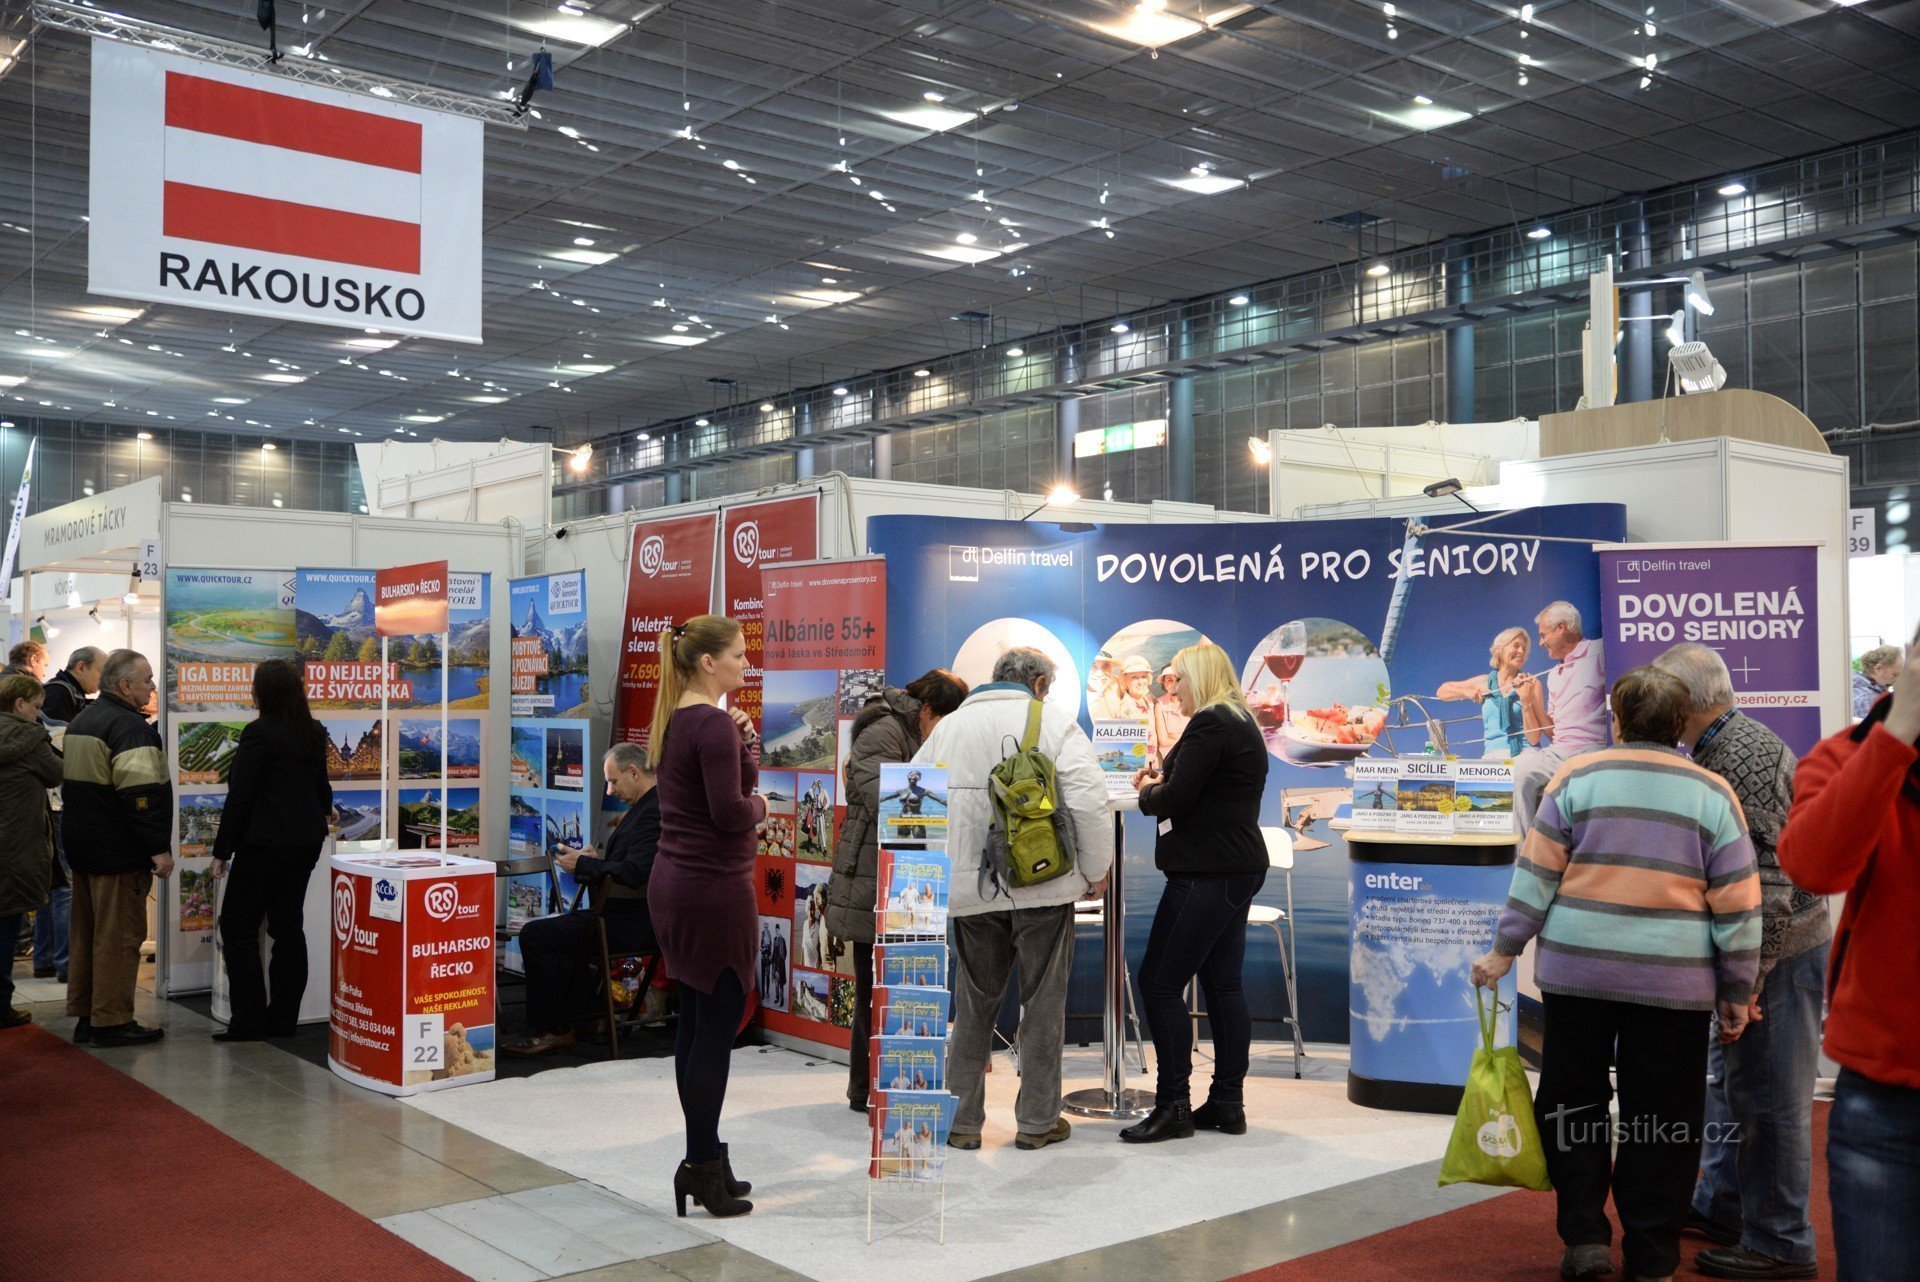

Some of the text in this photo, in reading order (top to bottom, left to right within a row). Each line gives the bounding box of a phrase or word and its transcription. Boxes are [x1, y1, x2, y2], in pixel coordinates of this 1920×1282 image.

[159, 251, 426, 322] RAKOUSKO
[44, 510, 95, 548] MRAMOROVÉ
[98, 506, 127, 534] TÁCKY
[1852, 515, 1864, 530] F
[147, 544, 155, 557] F
[738, 529, 776, 560] RS tour
[1850, 536, 1870, 552] 39
[644, 543, 678, 571] RS tour
[982, 547, 1026, 565] Delfin
[1031, 550, 1073, 566] travel
[1096, 539, 1541, 584] DOVOLENÁ PRO SENIORY
[143, 562, 158, 576] 23
[1642, 560, 1676, 572] Delfin
[1679, 559, 1711, 571] travel
[177, 574, 253, 584] WWW.QUICKTOUR.CZ
[809, 576, 877, 587] www.dovolenaproseniory.cz
[381, 578, 441, 599] BULHARSKO ŘECKO
[1618, 586, 1805, 619] DOVOLENÁ
[767, 616, 875, 642] Albánie 55+
[1619, 618, 1804, 643] PRO SENIORY
[512, 637, 541, 656] POBYTOVÉ
[628, 636, 655, 652] sleva
[766, 645, 876, 659] nová láska ve Středomoří
[181, 666, 208, 682] IGA
[307, 665, 326, 681] TO
[181, 683, 226, 693] MEZINÁRODNÍ
[307, 683, 324, 699] ZE
[740, 690, 762, 702] 6.990
[1095, 726, 1146, 737] KALÁBRIE
[1356, 766, 1375, 774] MAR
[1407, 762, 1447, 774] SICÍLIE
[1459, 767, 1511, 776] MENORCA
[1365, 872, 1423, 891] enter
[429, 886, 480, 915] RS tour
[1397, 896, 1432, 905] charterová
[1434, 898, 1469, 906] společnost
[336, 888, 351, 930] RS
[354, 924, 379, 947] tour
[1370, 904, 1388, 912] druhá
[1390, 906, 1415, 914] největší
[1458, 909, 1487, 917] východní
[1370, 914, 1391, 922] letadla
[1409, 916, 1432, 926] Boeing
[1434, 918, 1461, 926] 737-400
[1370, 933, 1390, 941] držitel
[1391, 935, 1424, 943] certifikátu
[1425, 937, 1464, 946] bezpečnosti
[1473, 939, 1492, 947] kvality
[1458, 928, 1482, 936] Evropě,
[412, 936, 491, 958] BULHARSKO
[430, 961, 474, 979] ŘECKO
[414, 986, 487, 1004] VAŠE SPOKOJENOST,
[423, 998, 479, 1014] NAŠE REKLAMA
[359, 1019, 369, 1031] 563
[369, 1022, 381, 1034] 034
[382, 1025, 396, 1037] 044
[420, 1022, 432, 1039] F
[350, 1032, 390, 1052] info@rstour.cz
[414, 1046, 438, 1063] 22
